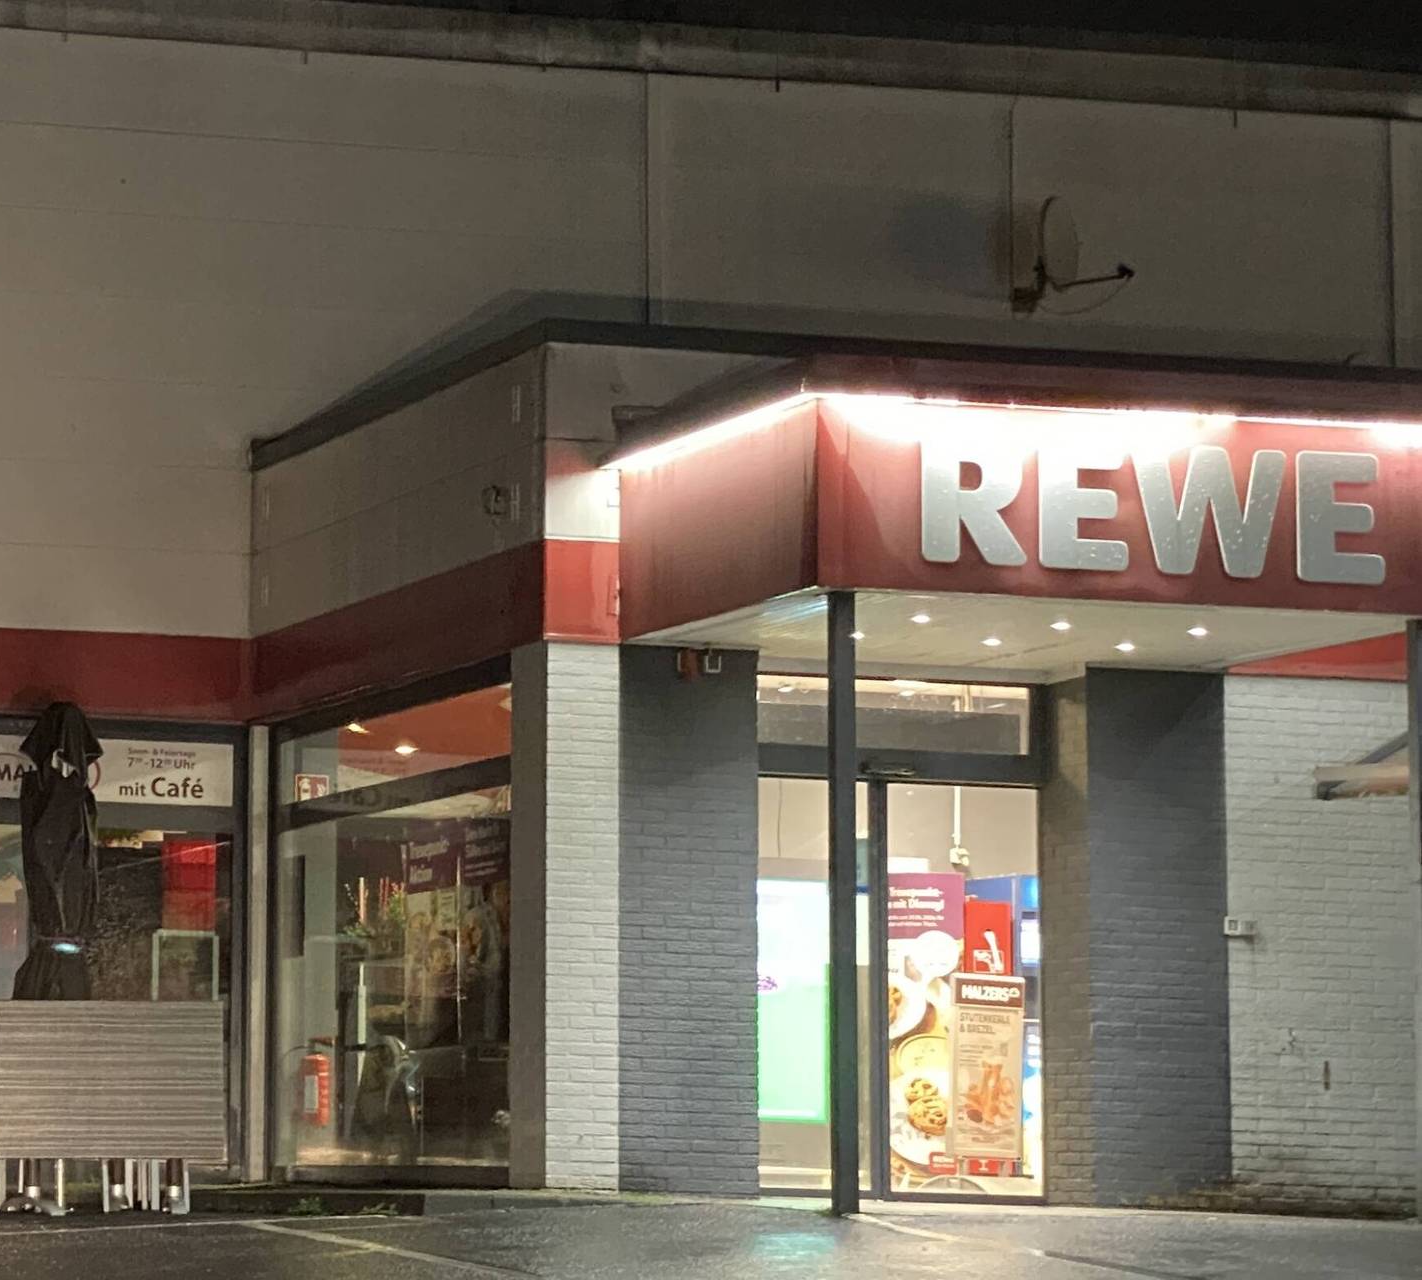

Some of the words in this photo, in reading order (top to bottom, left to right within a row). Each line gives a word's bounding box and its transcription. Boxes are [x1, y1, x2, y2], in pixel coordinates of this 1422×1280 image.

[920, 438, 1386, 585] REWE
[173, 759, 196, 770] Uhr
[119, 783, 146, 797] mit
[151, 777, 204, 799] Café
